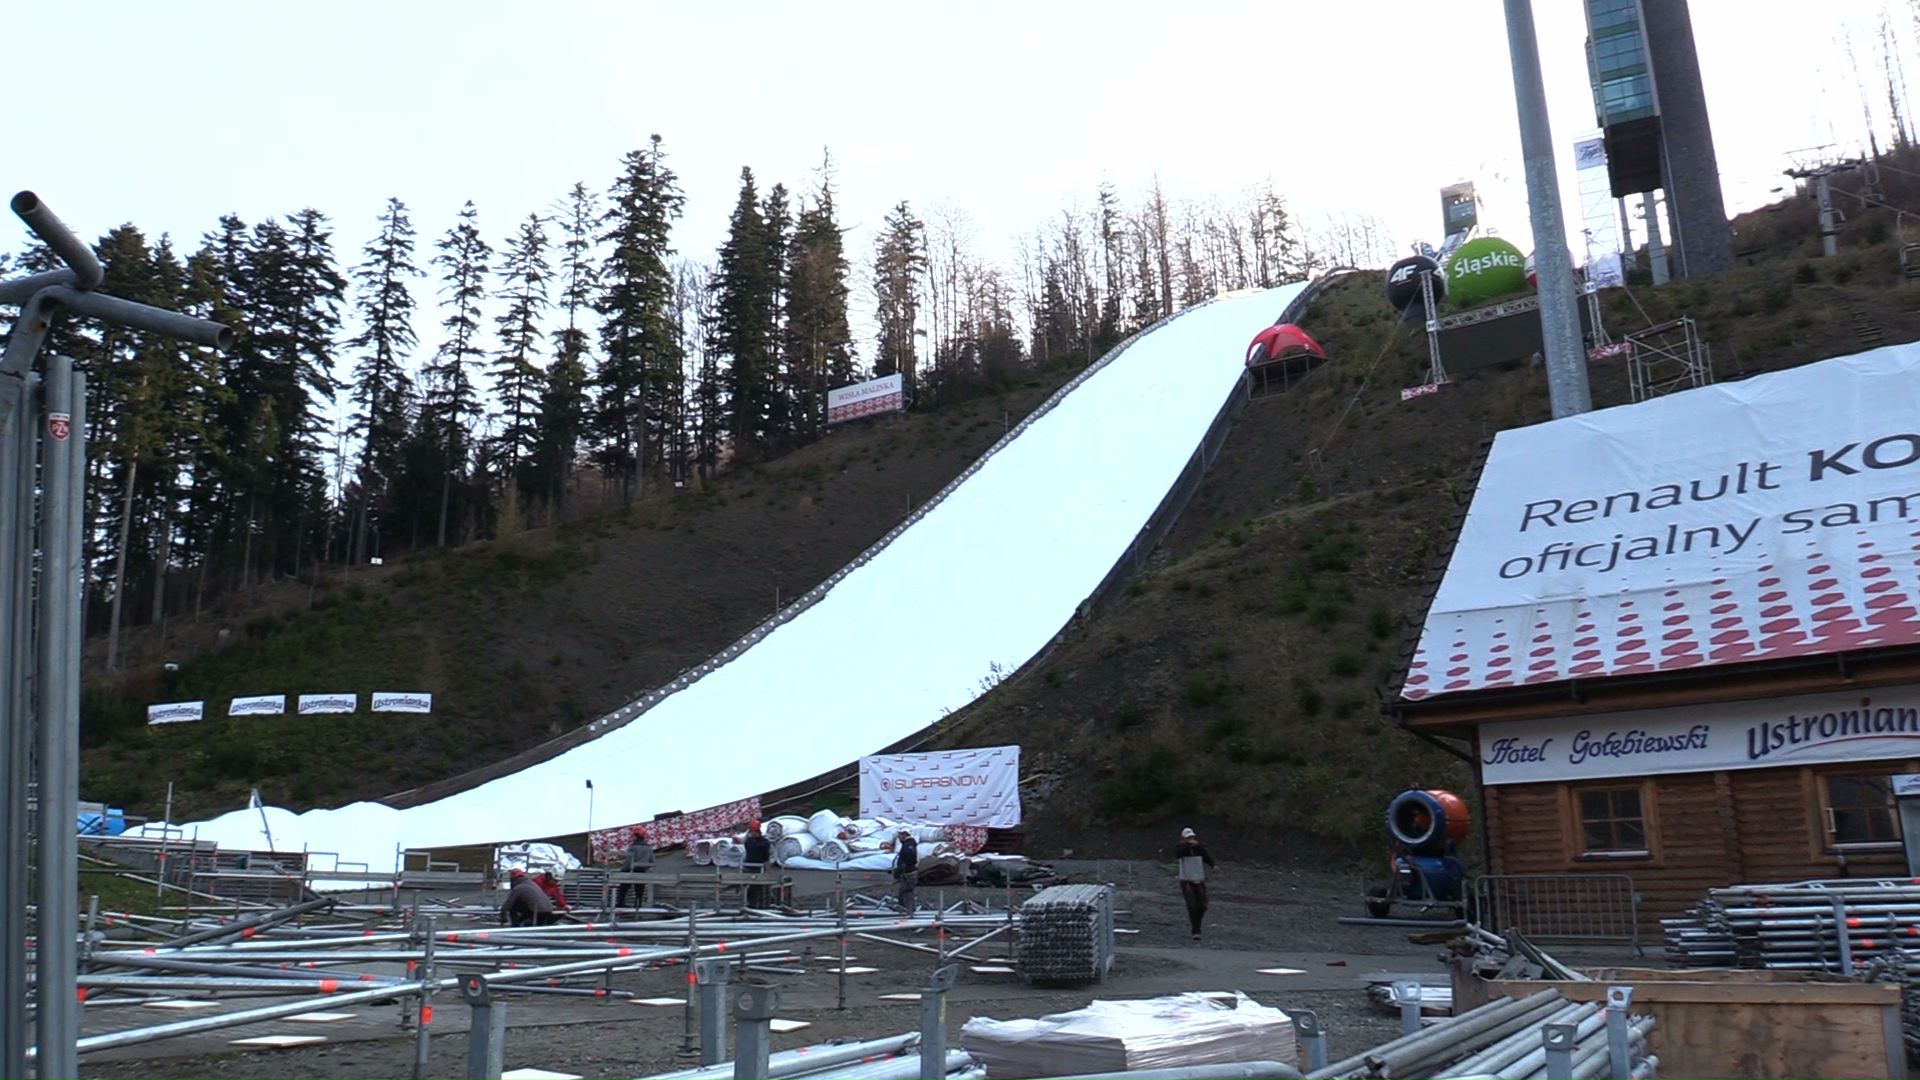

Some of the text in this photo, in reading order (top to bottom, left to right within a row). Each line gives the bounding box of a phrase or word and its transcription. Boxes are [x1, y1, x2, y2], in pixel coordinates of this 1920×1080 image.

[1390, 264, 1417, 283] 4F
[1519, 462, 1782, 533] Renault
[1499, 517, 1762, 579] oficjalny
[1483, 725, 1710, 765] Hotel Gołębiewski
[894, 774, 989, 790] SUPERSNOW
